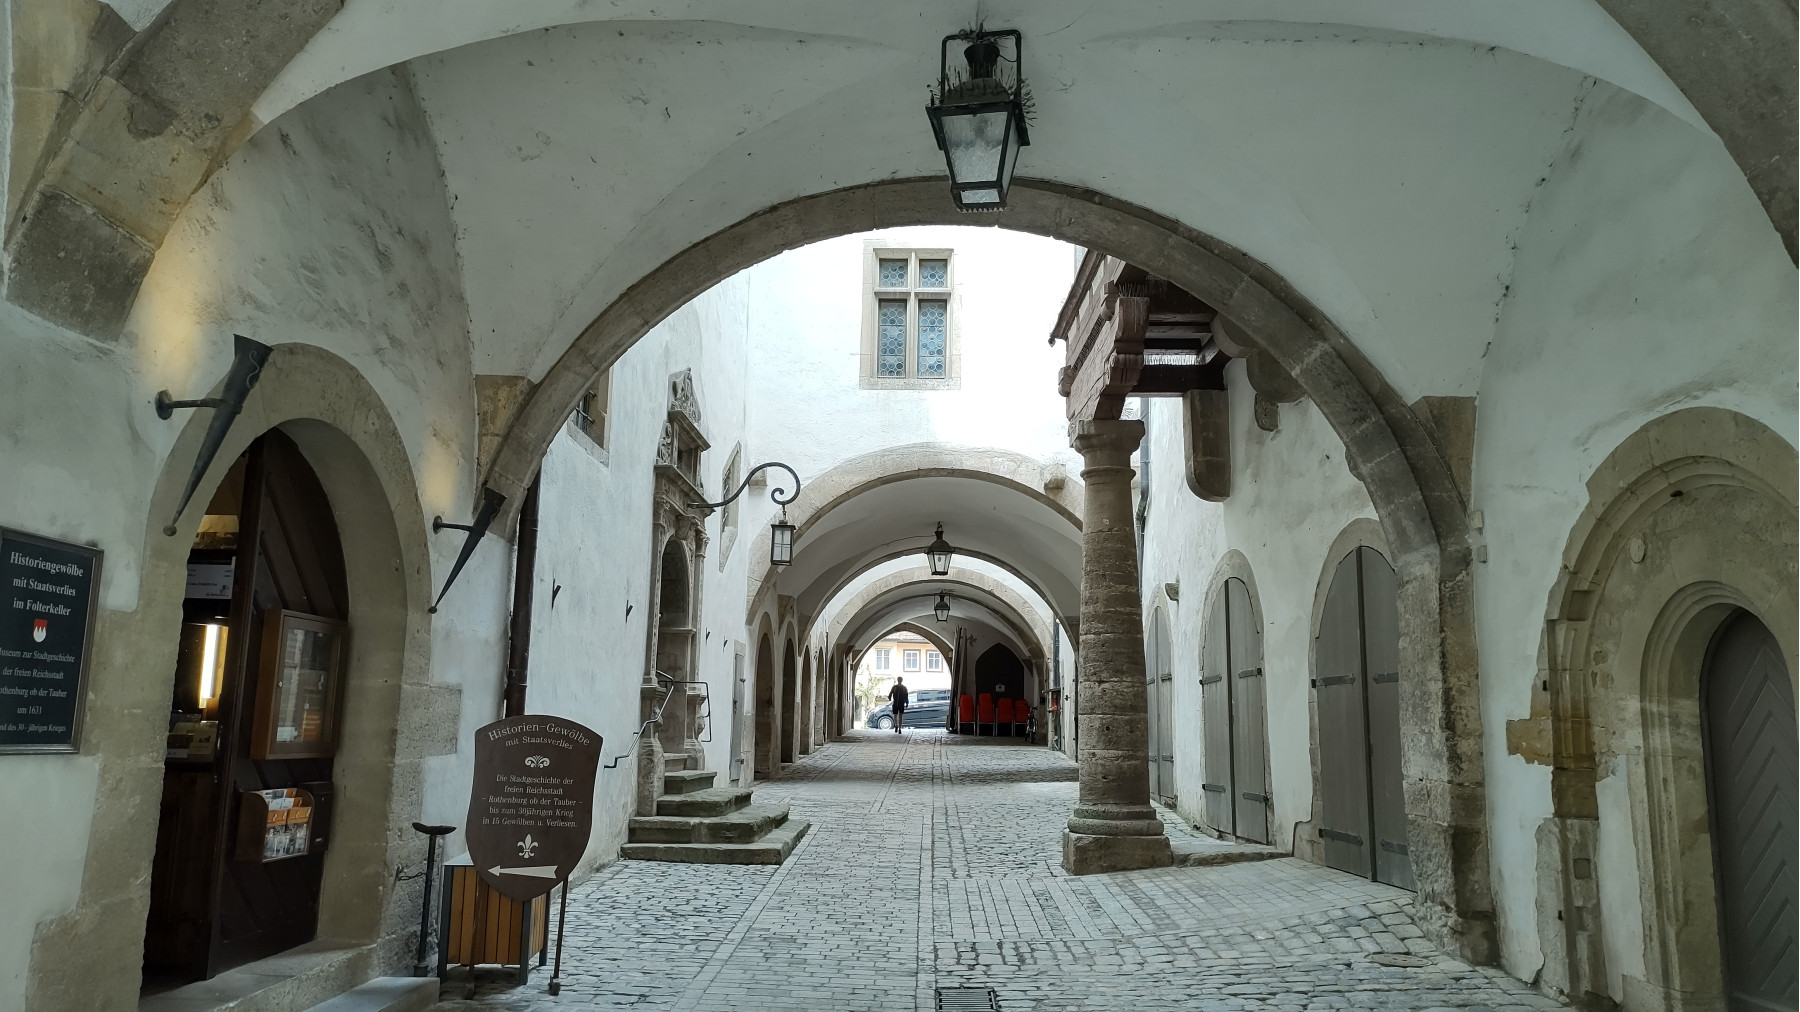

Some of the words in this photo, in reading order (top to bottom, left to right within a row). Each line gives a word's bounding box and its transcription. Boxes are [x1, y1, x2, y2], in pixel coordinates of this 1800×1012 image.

[10, 551, 84, 577] Historiengewölbe
[13, 577, 27, 588] mit
[28, 578, 76, 597] Staatsverlies
[13, 597, 24, 609] im
[26, 599, 71, 616] Folterkeller
[22, 651, 32, 659] zur
[33, 650, 75, 662] Stadtgeschichte
[2, 667, 13, 676] der
[14, 667, 31, 677] freien
[32, 668, 64, 680] Reichsstadt
[0, 685, 29, 698] othenburg
[29, 687, 38, 696] ob
[38, 688, 48, 697] der
[49, 688, 67, 698] Tauber
[17, 706, 27, 715] um
[28, 705, 42, 715] 1631
[7, 723, 17, 731] des
[488, 722, 590, 746] Historien-Gewölbe
[505, 738, 519, 747] mit
[522, 735, 574, 750] Staatsverlies
[496, 774, 508, 782] Die
[509, 774, 561, 784] Stadtgeschichte
[562, 777, 574, 785] der
[504, 785, 524, 793] freien
[526, 786, 563, 795] Reichsstadt
[488, 795, 528, 805] Rothenburg
[529, 797, 538, 805] ob
[540, 797, 551, 805] der
[553, 798, 577, 806] Tauber
[489, 806, 499, 814] bis
[518, 807, 553, 817] 30jährigen
[555, 808, 574, 817] Krieg
[482, 817, 490, 825] in
[491, 817, 500, 825] 15
[501, 817, 535, 826] Gewölben
